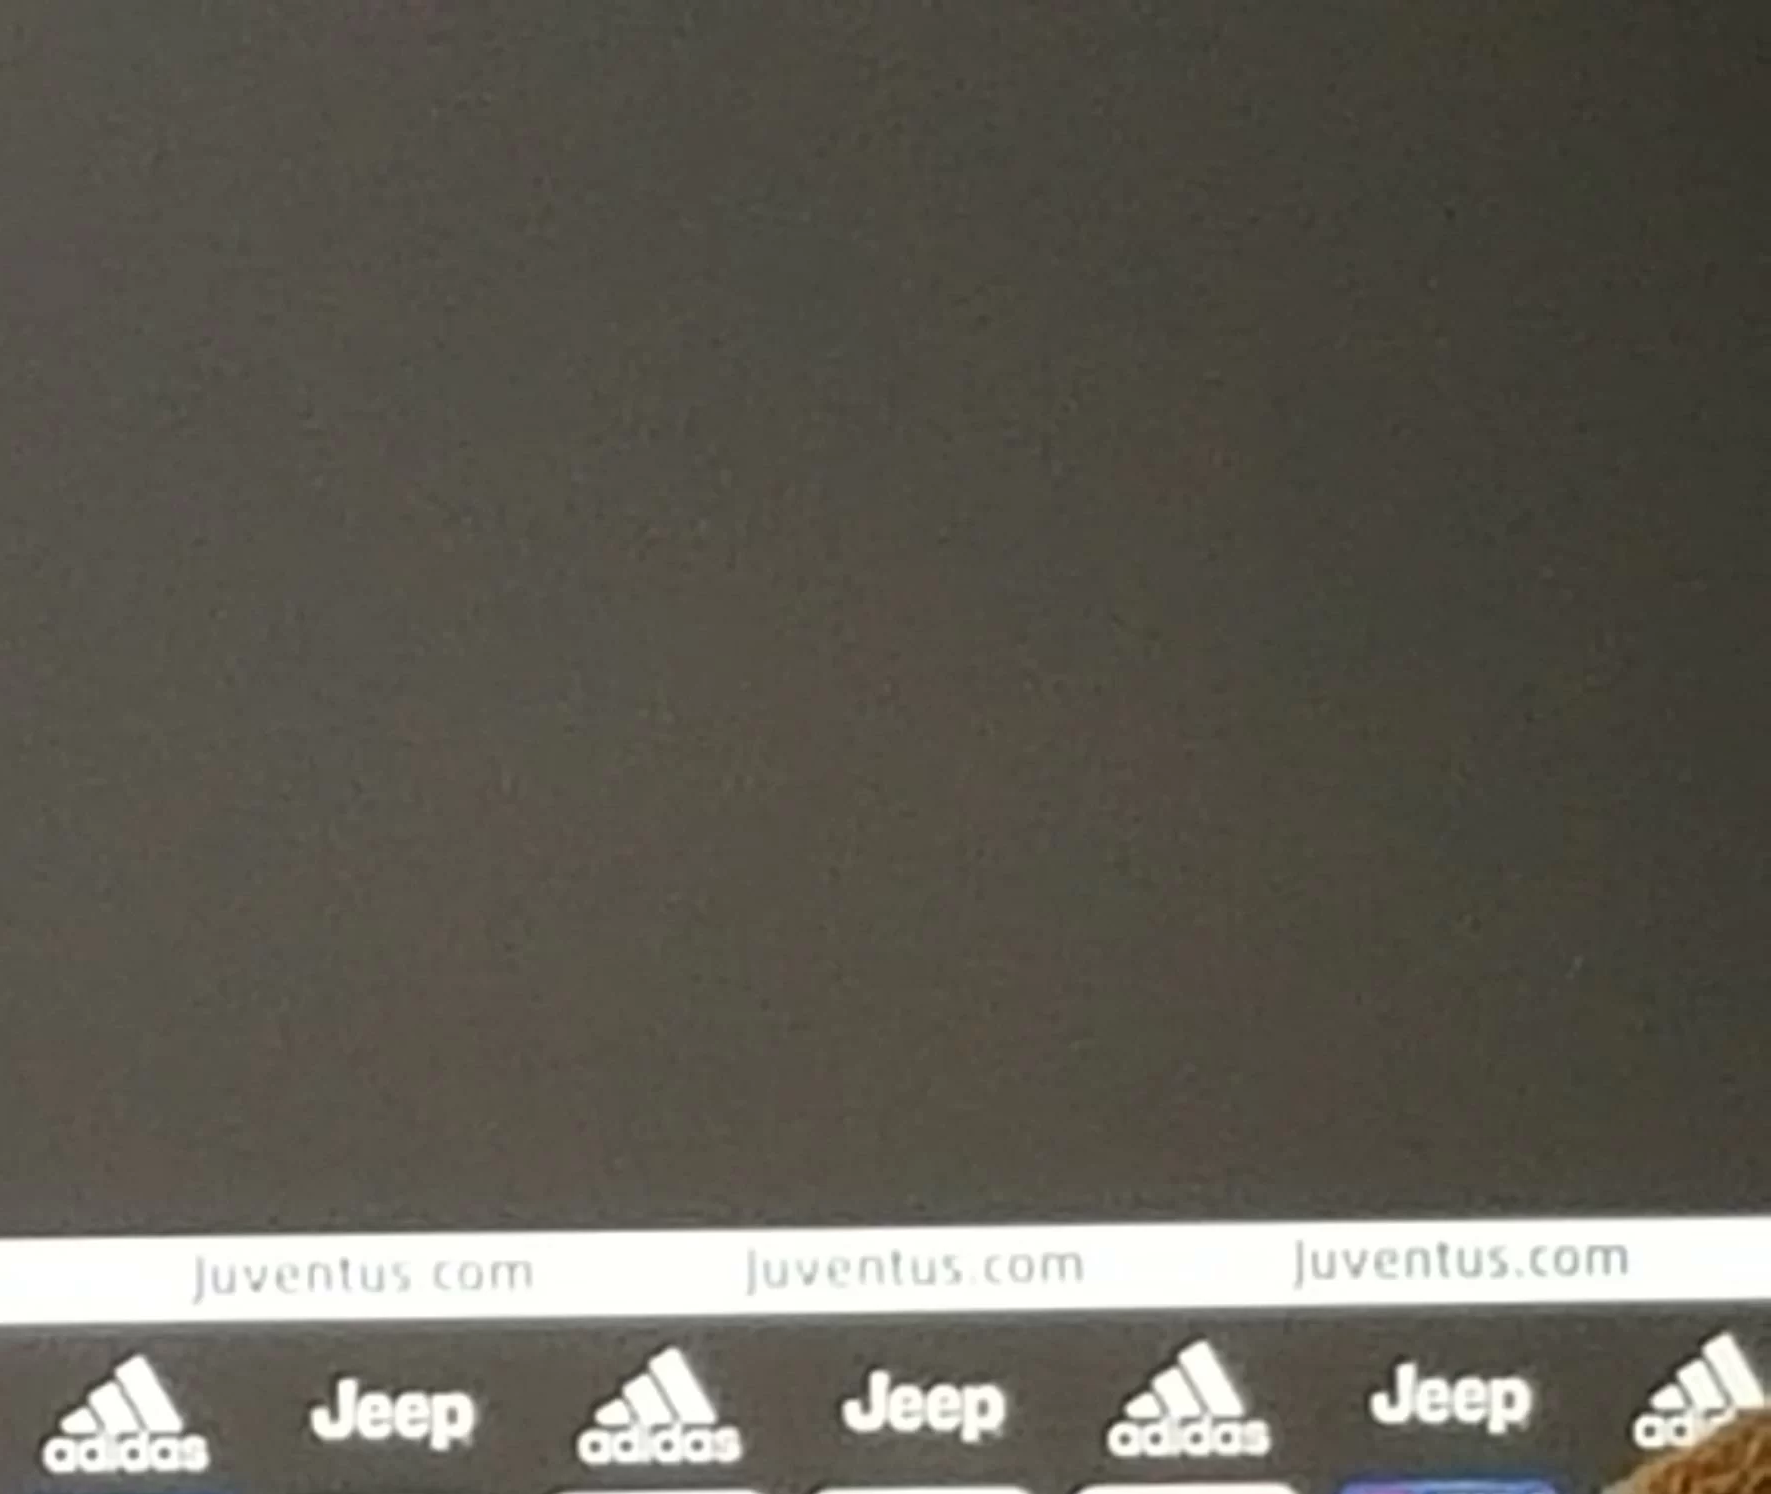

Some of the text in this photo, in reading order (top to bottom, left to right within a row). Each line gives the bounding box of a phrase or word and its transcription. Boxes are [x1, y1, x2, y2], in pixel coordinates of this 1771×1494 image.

[191, 1255, 534, 1306] Juventuscom
[1293, 1239, 1631, 1292] Juventus.com
[310, 1379, 477, 1451] Jeep
[842, 1370, 1006, 1442] Jeep
[1370, 1365, 1533, 1434] Jeep
[42, 1433, 210, 1474] adidas
[577, 1423, 743, 1466] adidas
[1107, 1415, 1272, 1458] adidas
